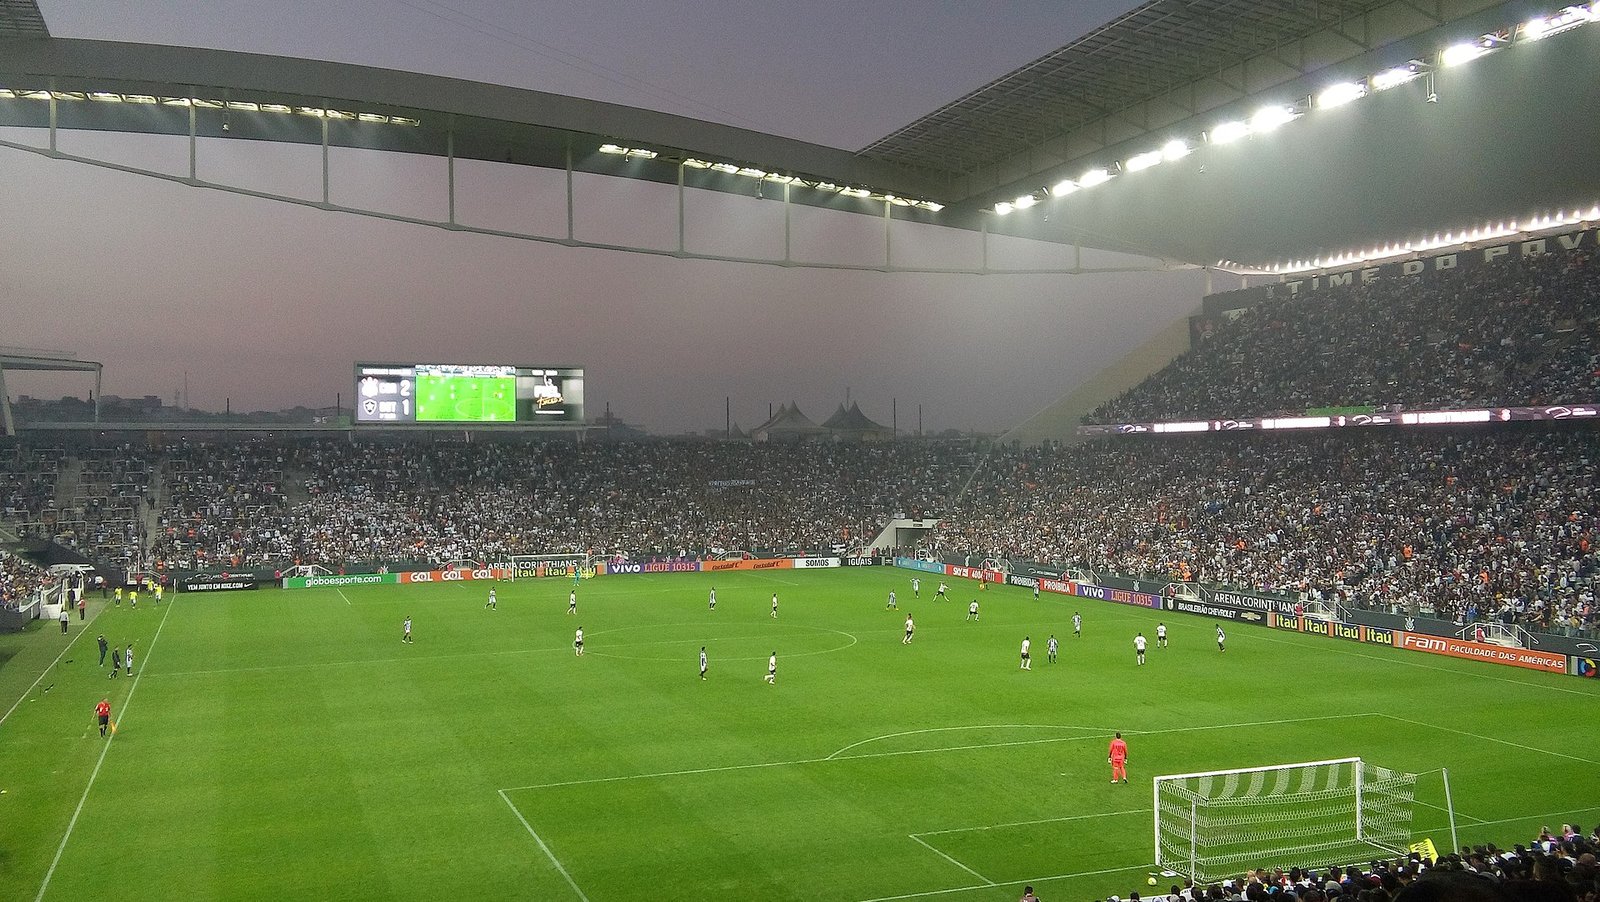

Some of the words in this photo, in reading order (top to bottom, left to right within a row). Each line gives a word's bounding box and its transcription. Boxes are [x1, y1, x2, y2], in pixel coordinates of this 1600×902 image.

[1286, 267, 1380, 298] TIME
[1403, 254, 1457, 276] DO
[1484, 229, 1600, 263] POV
[400, 379, 411, 397] 2
[402, 398, 410, 416] 1
[487, 562, 518, 570] ARENA
[520, 560, 577, 569] CORINTHIANS
[644, 563, 669, 573] LIGUE
[672, 562, 696, 572] 10315
[805, 558, 830, 567] SOMOS
[848, 557, 873, 566] IGUAIS
[410, 571, 434, 582] GOL
[441, 570, 464, 580] GOL
[472, 569, 494, 579] GOL
[514, 566, 536, 578] Itaú
[545, 566, 566, 576] Itaú
[187, 583, 198, 591] VEM
[305, 575, 382, 588] globoesporte.com
[1111, 590, 1131, 603] LIGUE
[1133, 593, 1153, 607] 10315
[1214, 593, 1241, 606] ARENA
[1178, 602, 1208, 615] BRASILEIRÃO
[1208, 605, 1237, 619] CHEVROLET
[1276, 614, 1298, 629] Itaú
[1304, 619, 1328, 634] Itaú
[1335, 623, 1359, 639] Itaú
[1367, 628, 1392, 644] Itaú
[1449, 644, 1496, 658] FACULDADE
[1499, 651, 1516, 661] DAS
[1518, 654, 1564, 669] AMÉRICAS
